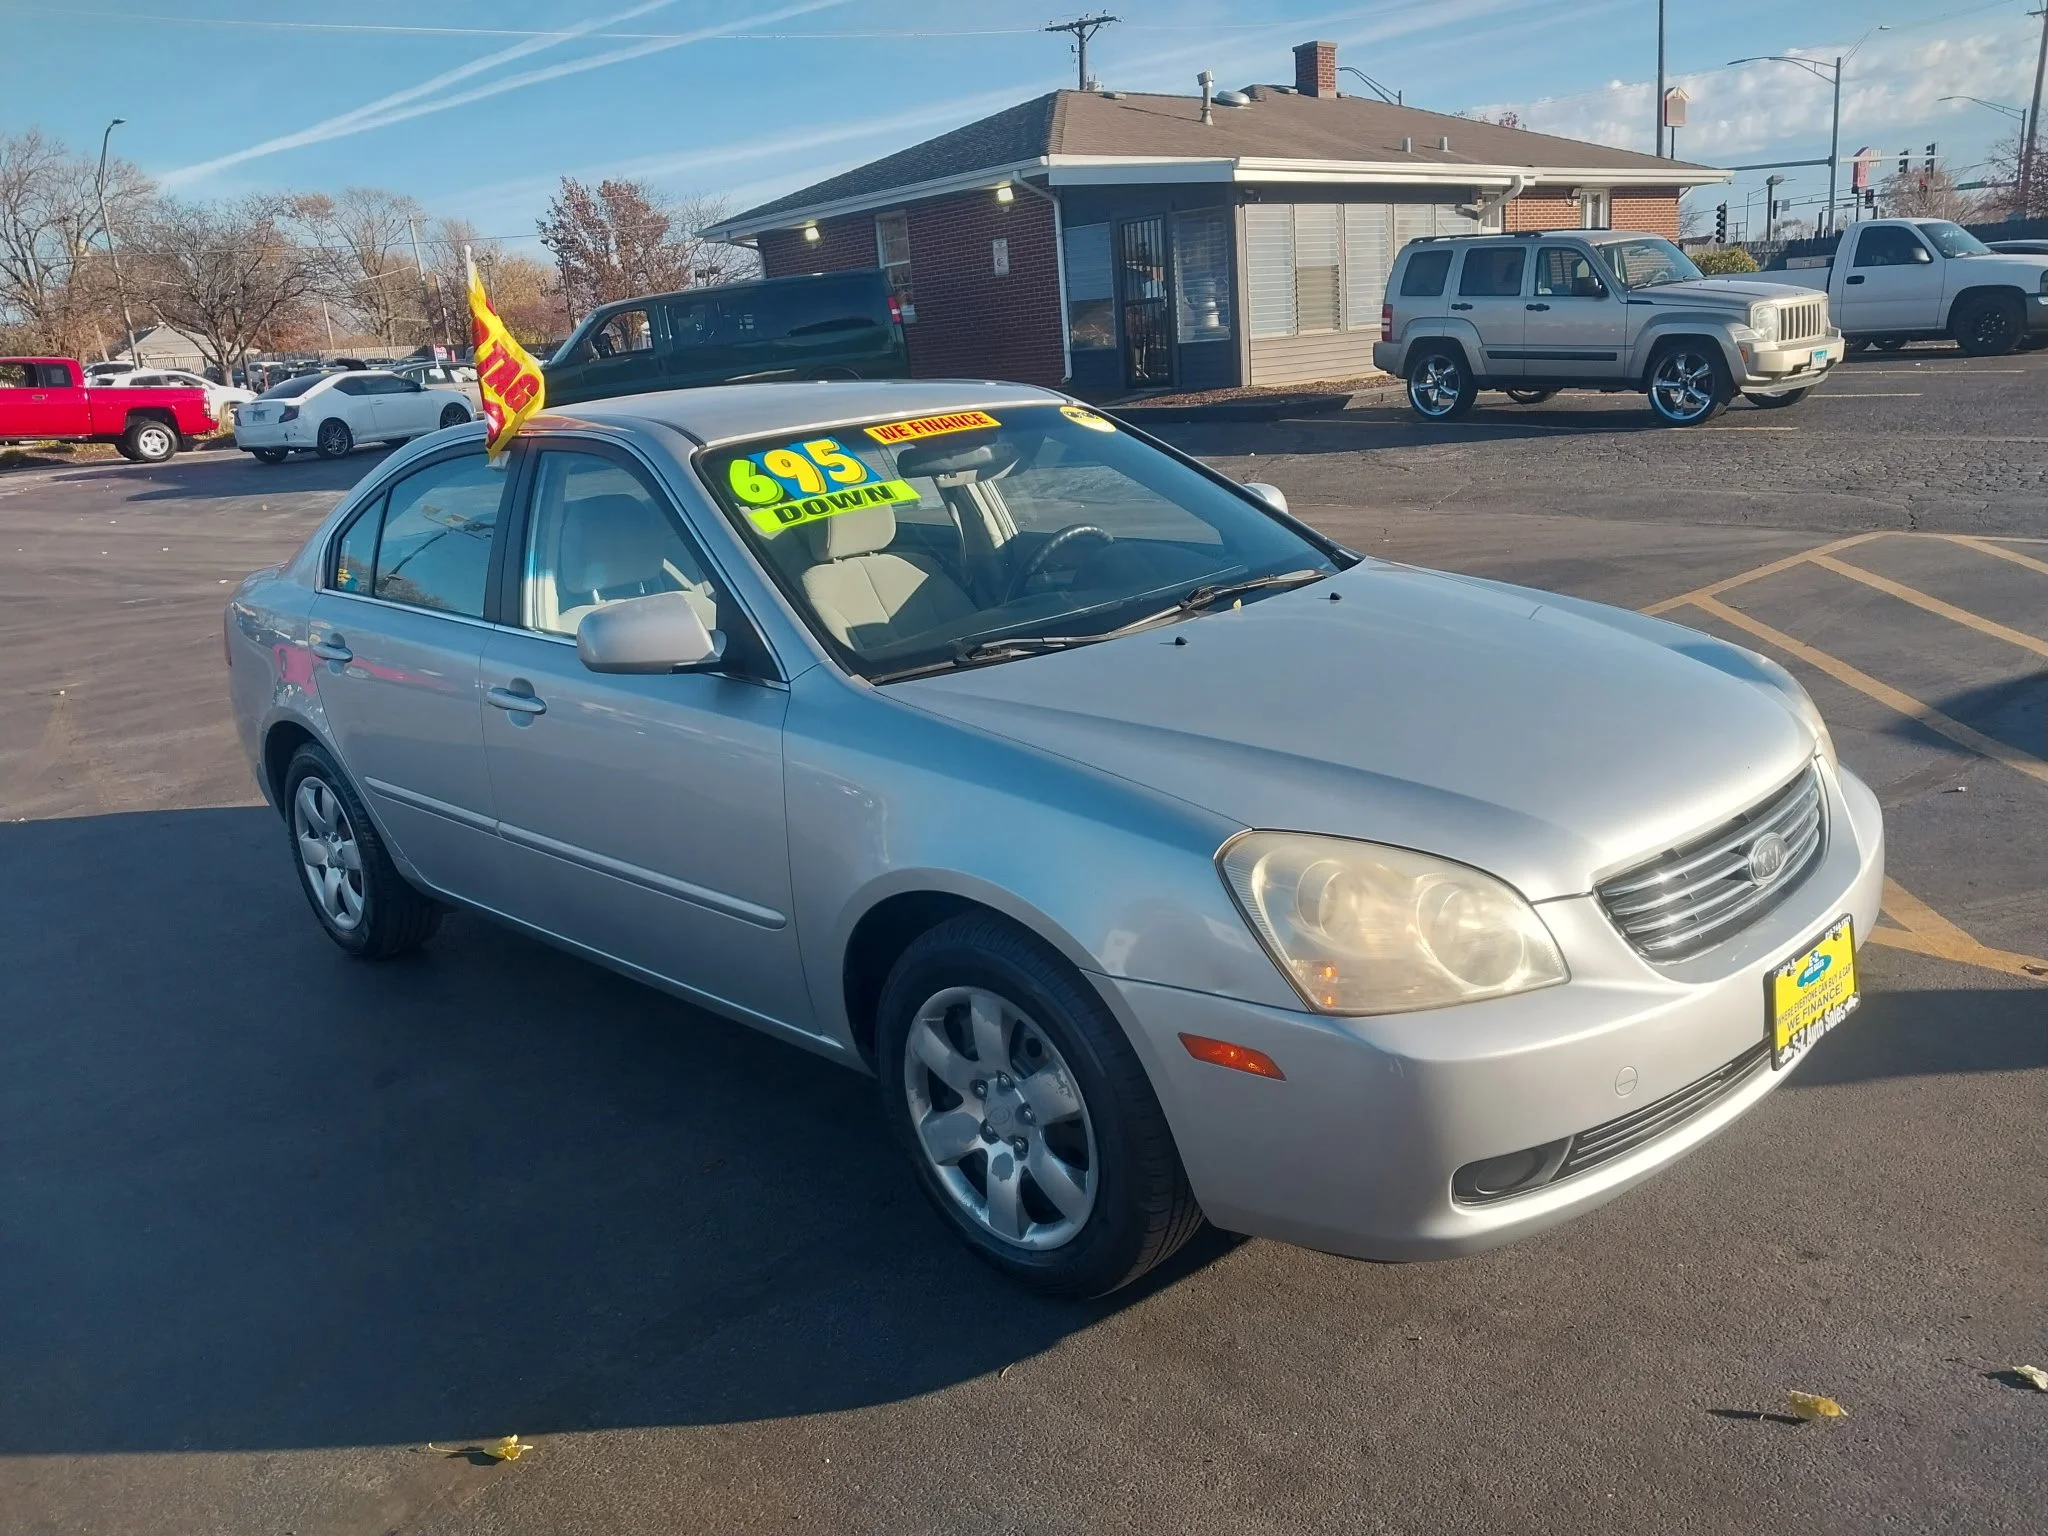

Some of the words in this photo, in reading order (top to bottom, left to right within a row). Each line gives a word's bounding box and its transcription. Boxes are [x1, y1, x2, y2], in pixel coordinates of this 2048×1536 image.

[874, 424, 911, 441] WE
[907, 413, 989, 434] FINANCE
[729, 439, 868, 505] 695
[773, 484, 896, 525] DOWN
[1787, 1013, 1800, 1032] WE
[1802, 981, 1843, 1020] FINANCE!
[1806, 1018, 1825, 1047] Auto
[1824, 1003, 1846, 1032] Sales
